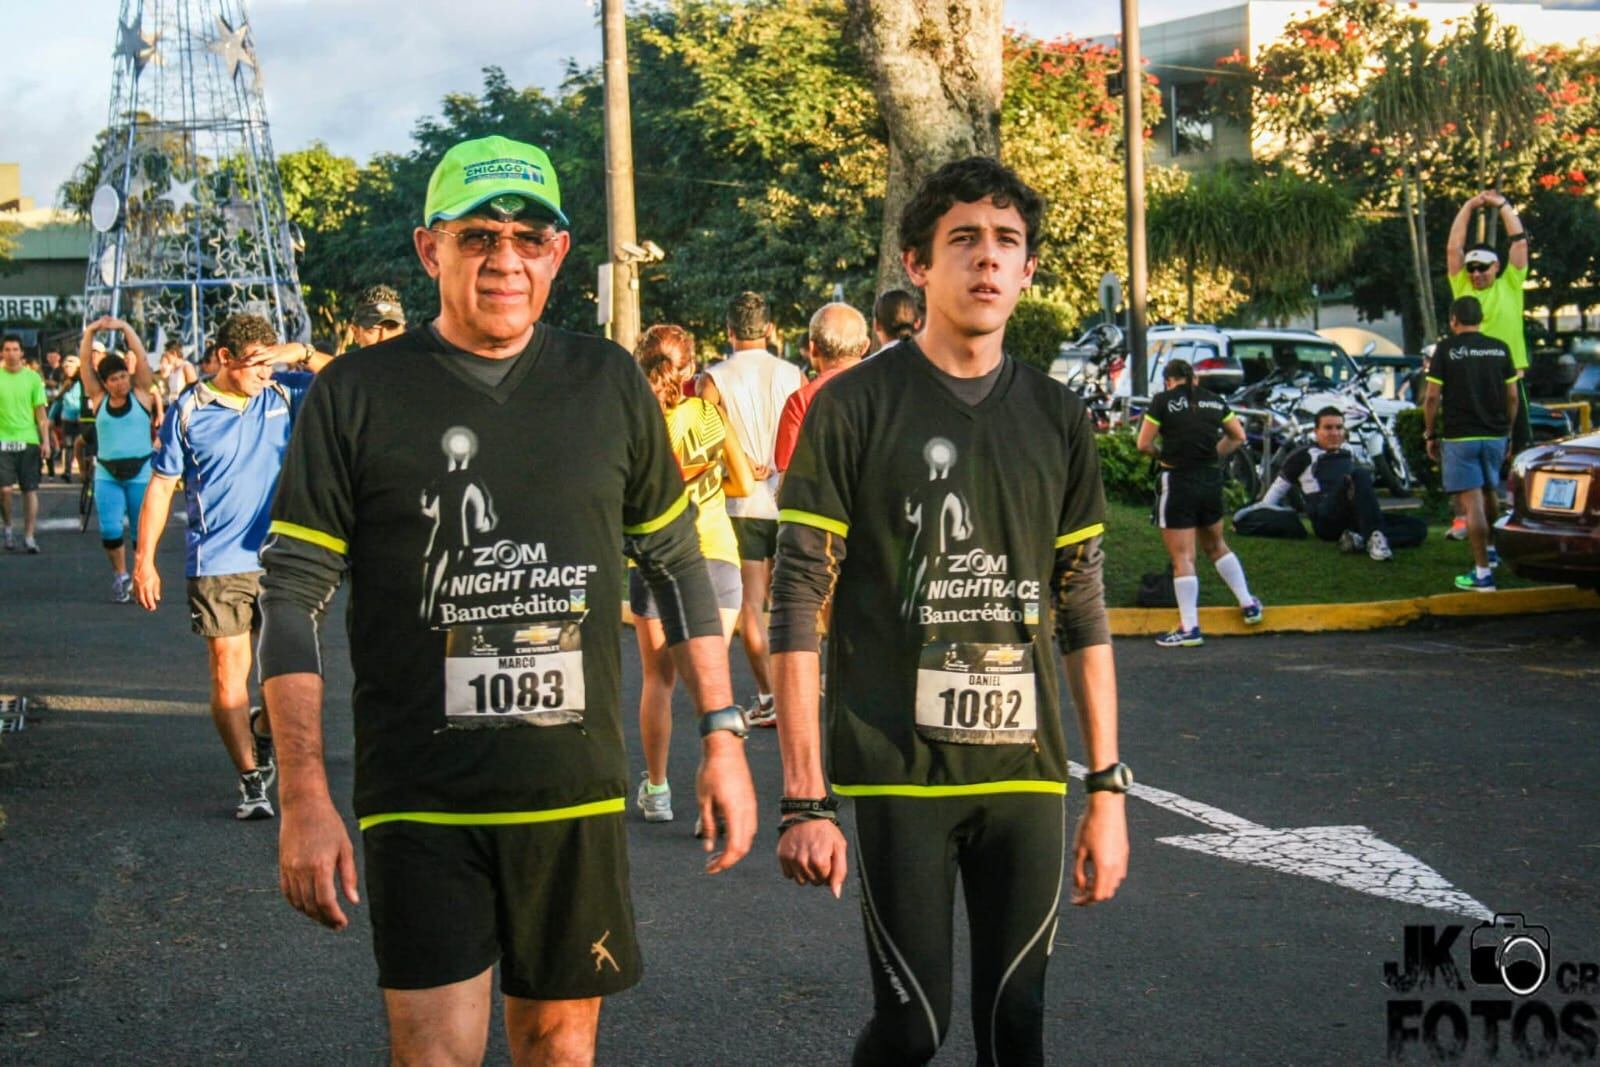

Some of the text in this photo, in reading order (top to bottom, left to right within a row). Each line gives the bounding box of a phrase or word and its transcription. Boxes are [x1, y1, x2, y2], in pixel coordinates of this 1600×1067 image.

[466, 163, 522, 177] CHICAGO
[450, 565, 588, 597] NIGHT RACE
[440, 593, 570, 624] Bancrédito
[498, 657, 536, 669] MARCO
[468, 669, 564, 713] 1083
[969, 675, 1001, 686] DANIEL
[939, 688, 1022, 729] 1082
